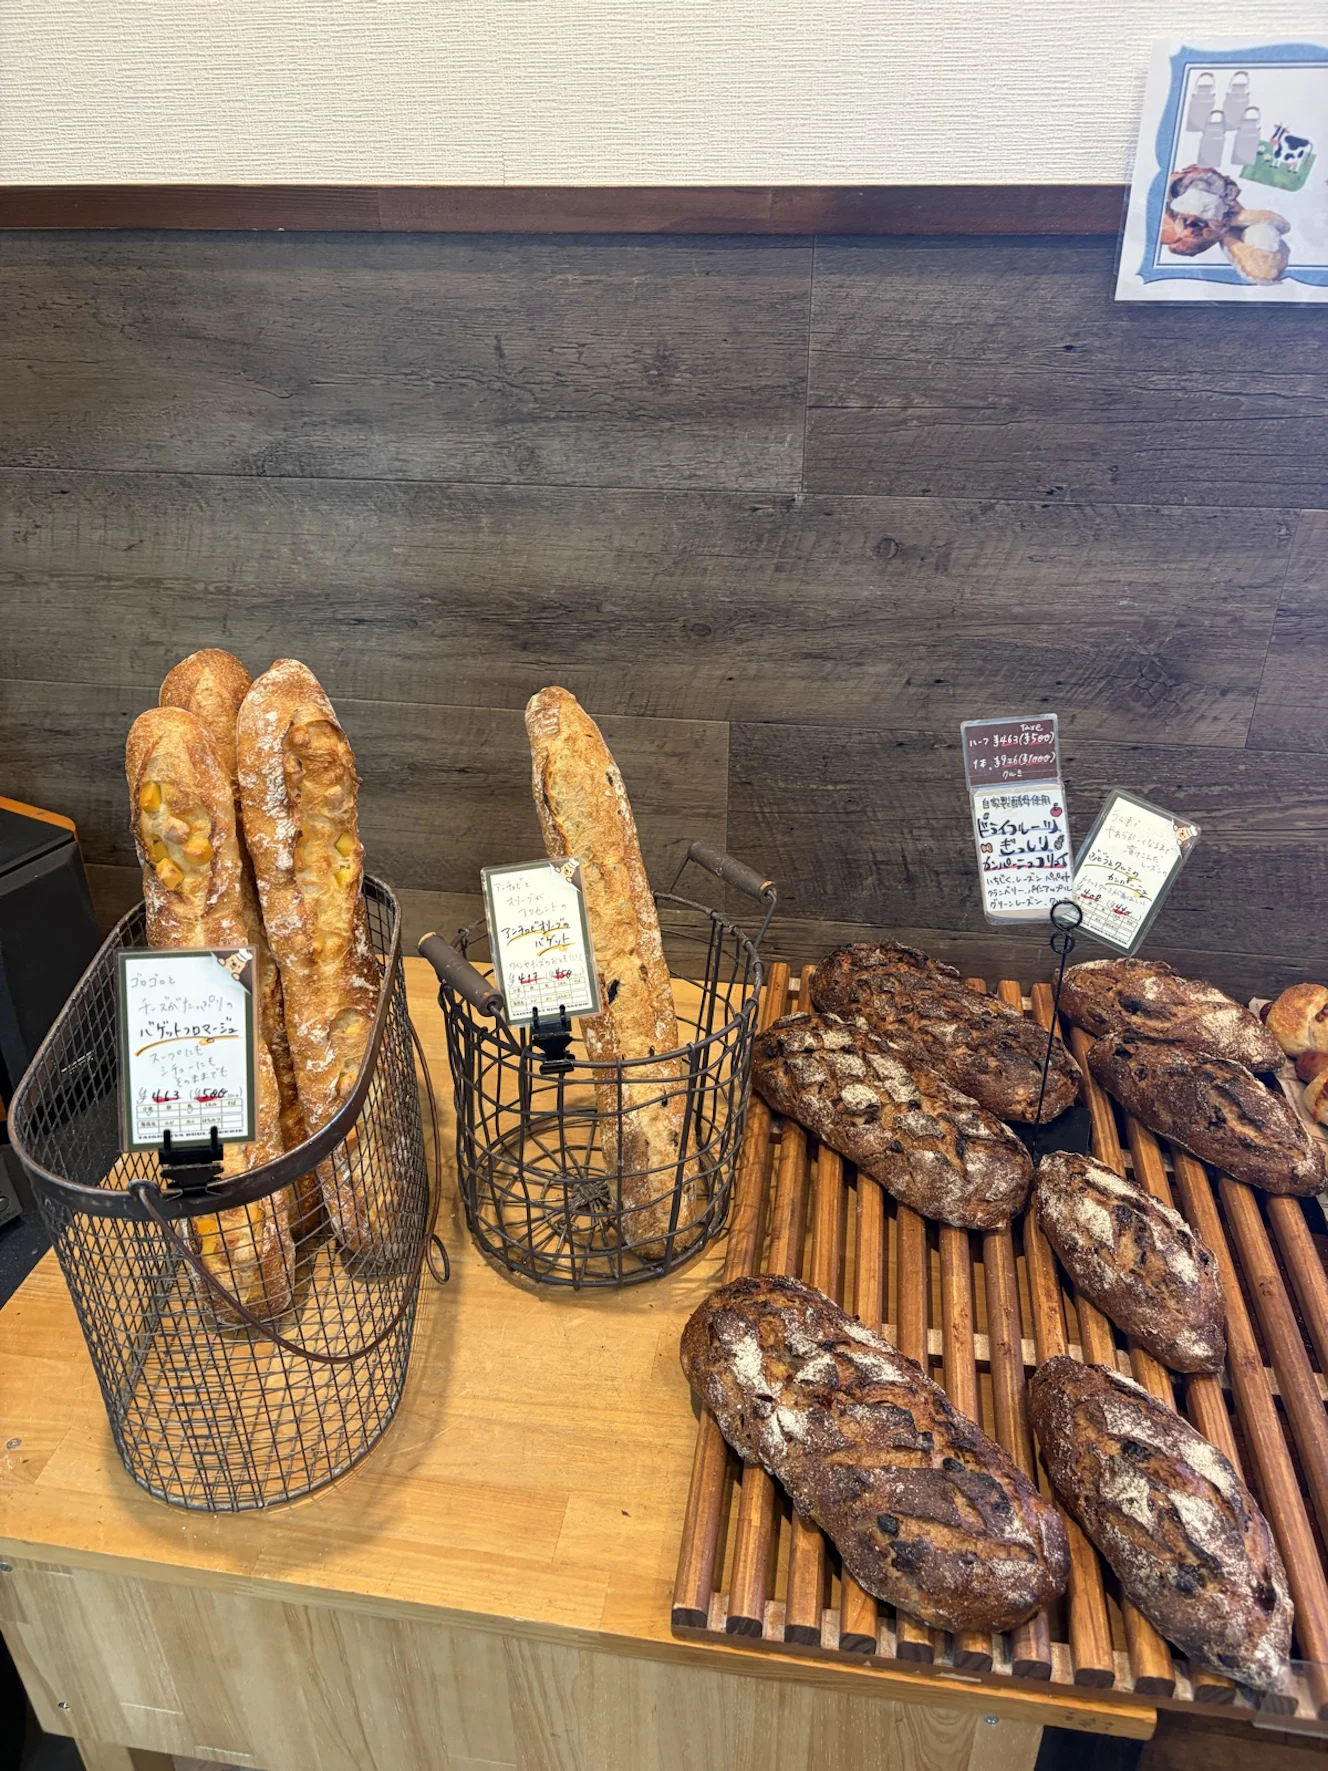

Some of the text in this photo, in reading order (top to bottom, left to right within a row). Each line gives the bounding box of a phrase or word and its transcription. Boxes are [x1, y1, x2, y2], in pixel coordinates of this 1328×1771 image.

[982, 794, 1051, 809] 自家製酵母使用
[977, 818, 1059, 838] ドライフルーツ
[1000, 836, 1049, 856] ぎっしり
[535, 932, 570, 948] バゲット
[130, 972, 176, 989] ゴロゴロと
[138, 994, 233, 1014] チーズがたっぷりの
[140, 1016, 238, 1039] バゲットフロマージュ
[149, 1044, 204, 1063] スープにも
[160, 1056, 217, 1076] シチューにも
[175, 1066, 228, 1087] そのままでも
